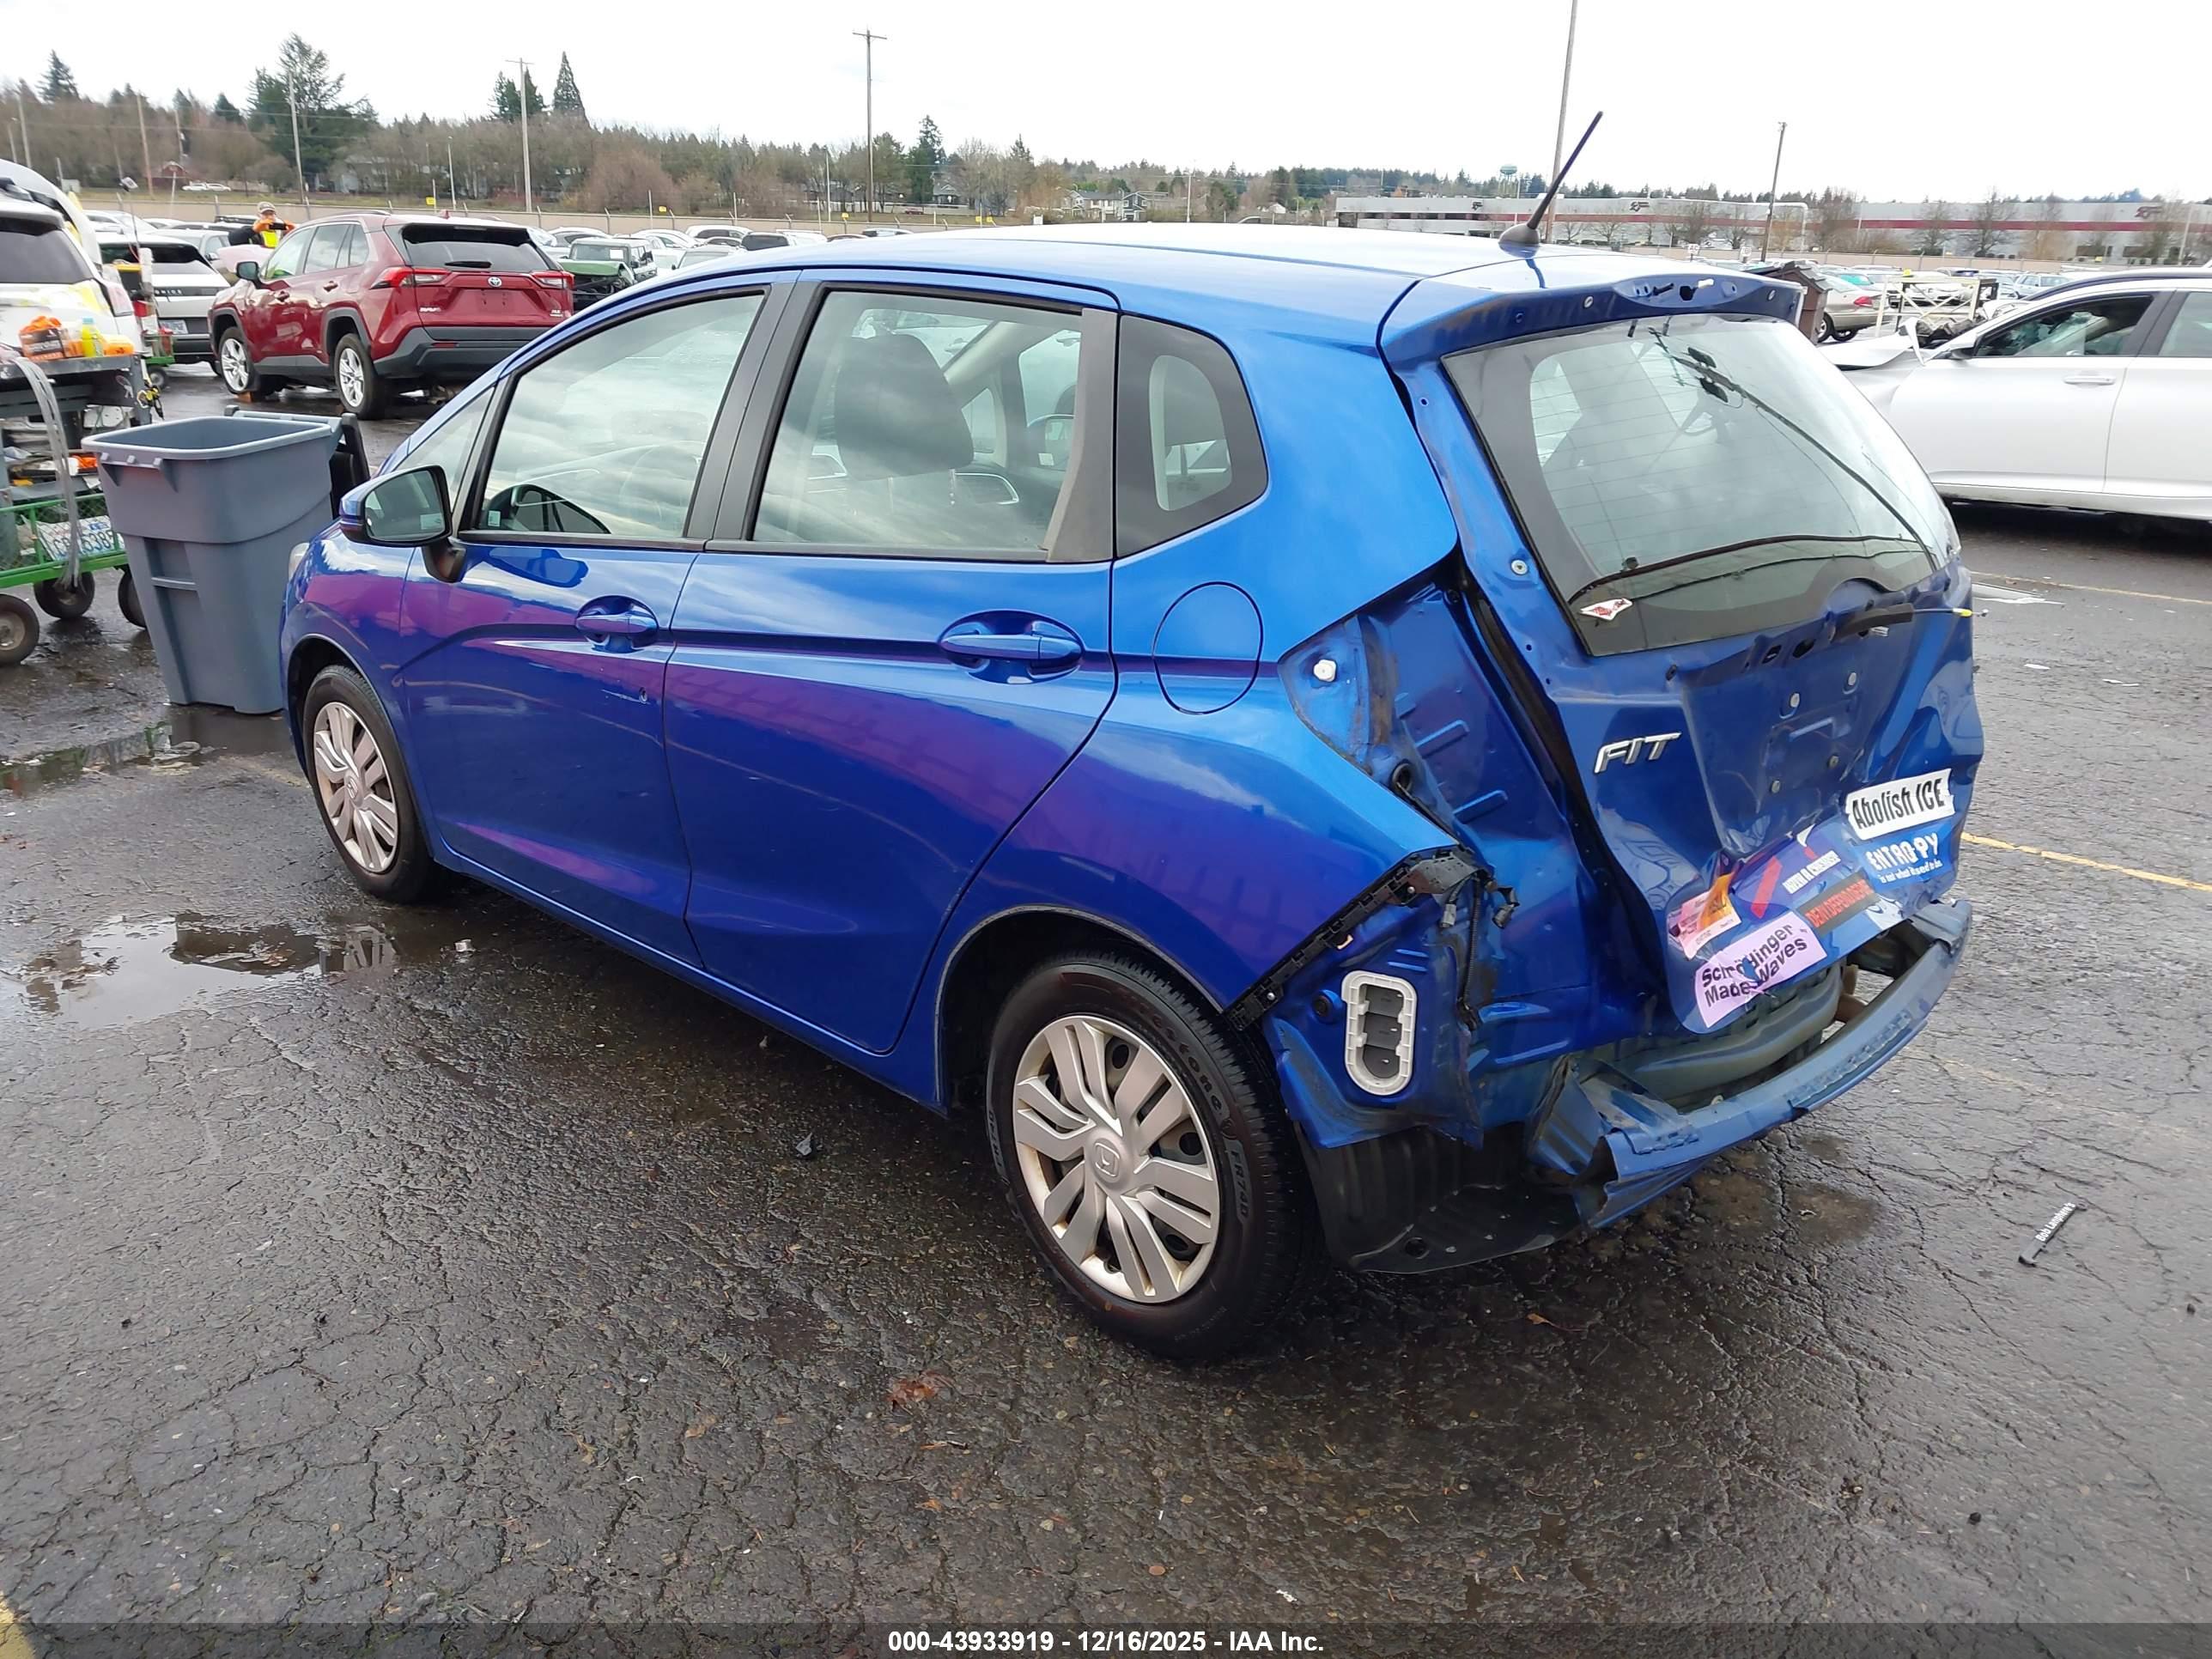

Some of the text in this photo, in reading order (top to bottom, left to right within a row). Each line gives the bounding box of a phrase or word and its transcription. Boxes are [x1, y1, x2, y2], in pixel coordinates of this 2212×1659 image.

[1594, 731, 1682, 775] FIT
[1851, 777, 1945, 830] Abolish ICE
[2035, 1202, 2076, 1242] Bob Lanphere's
